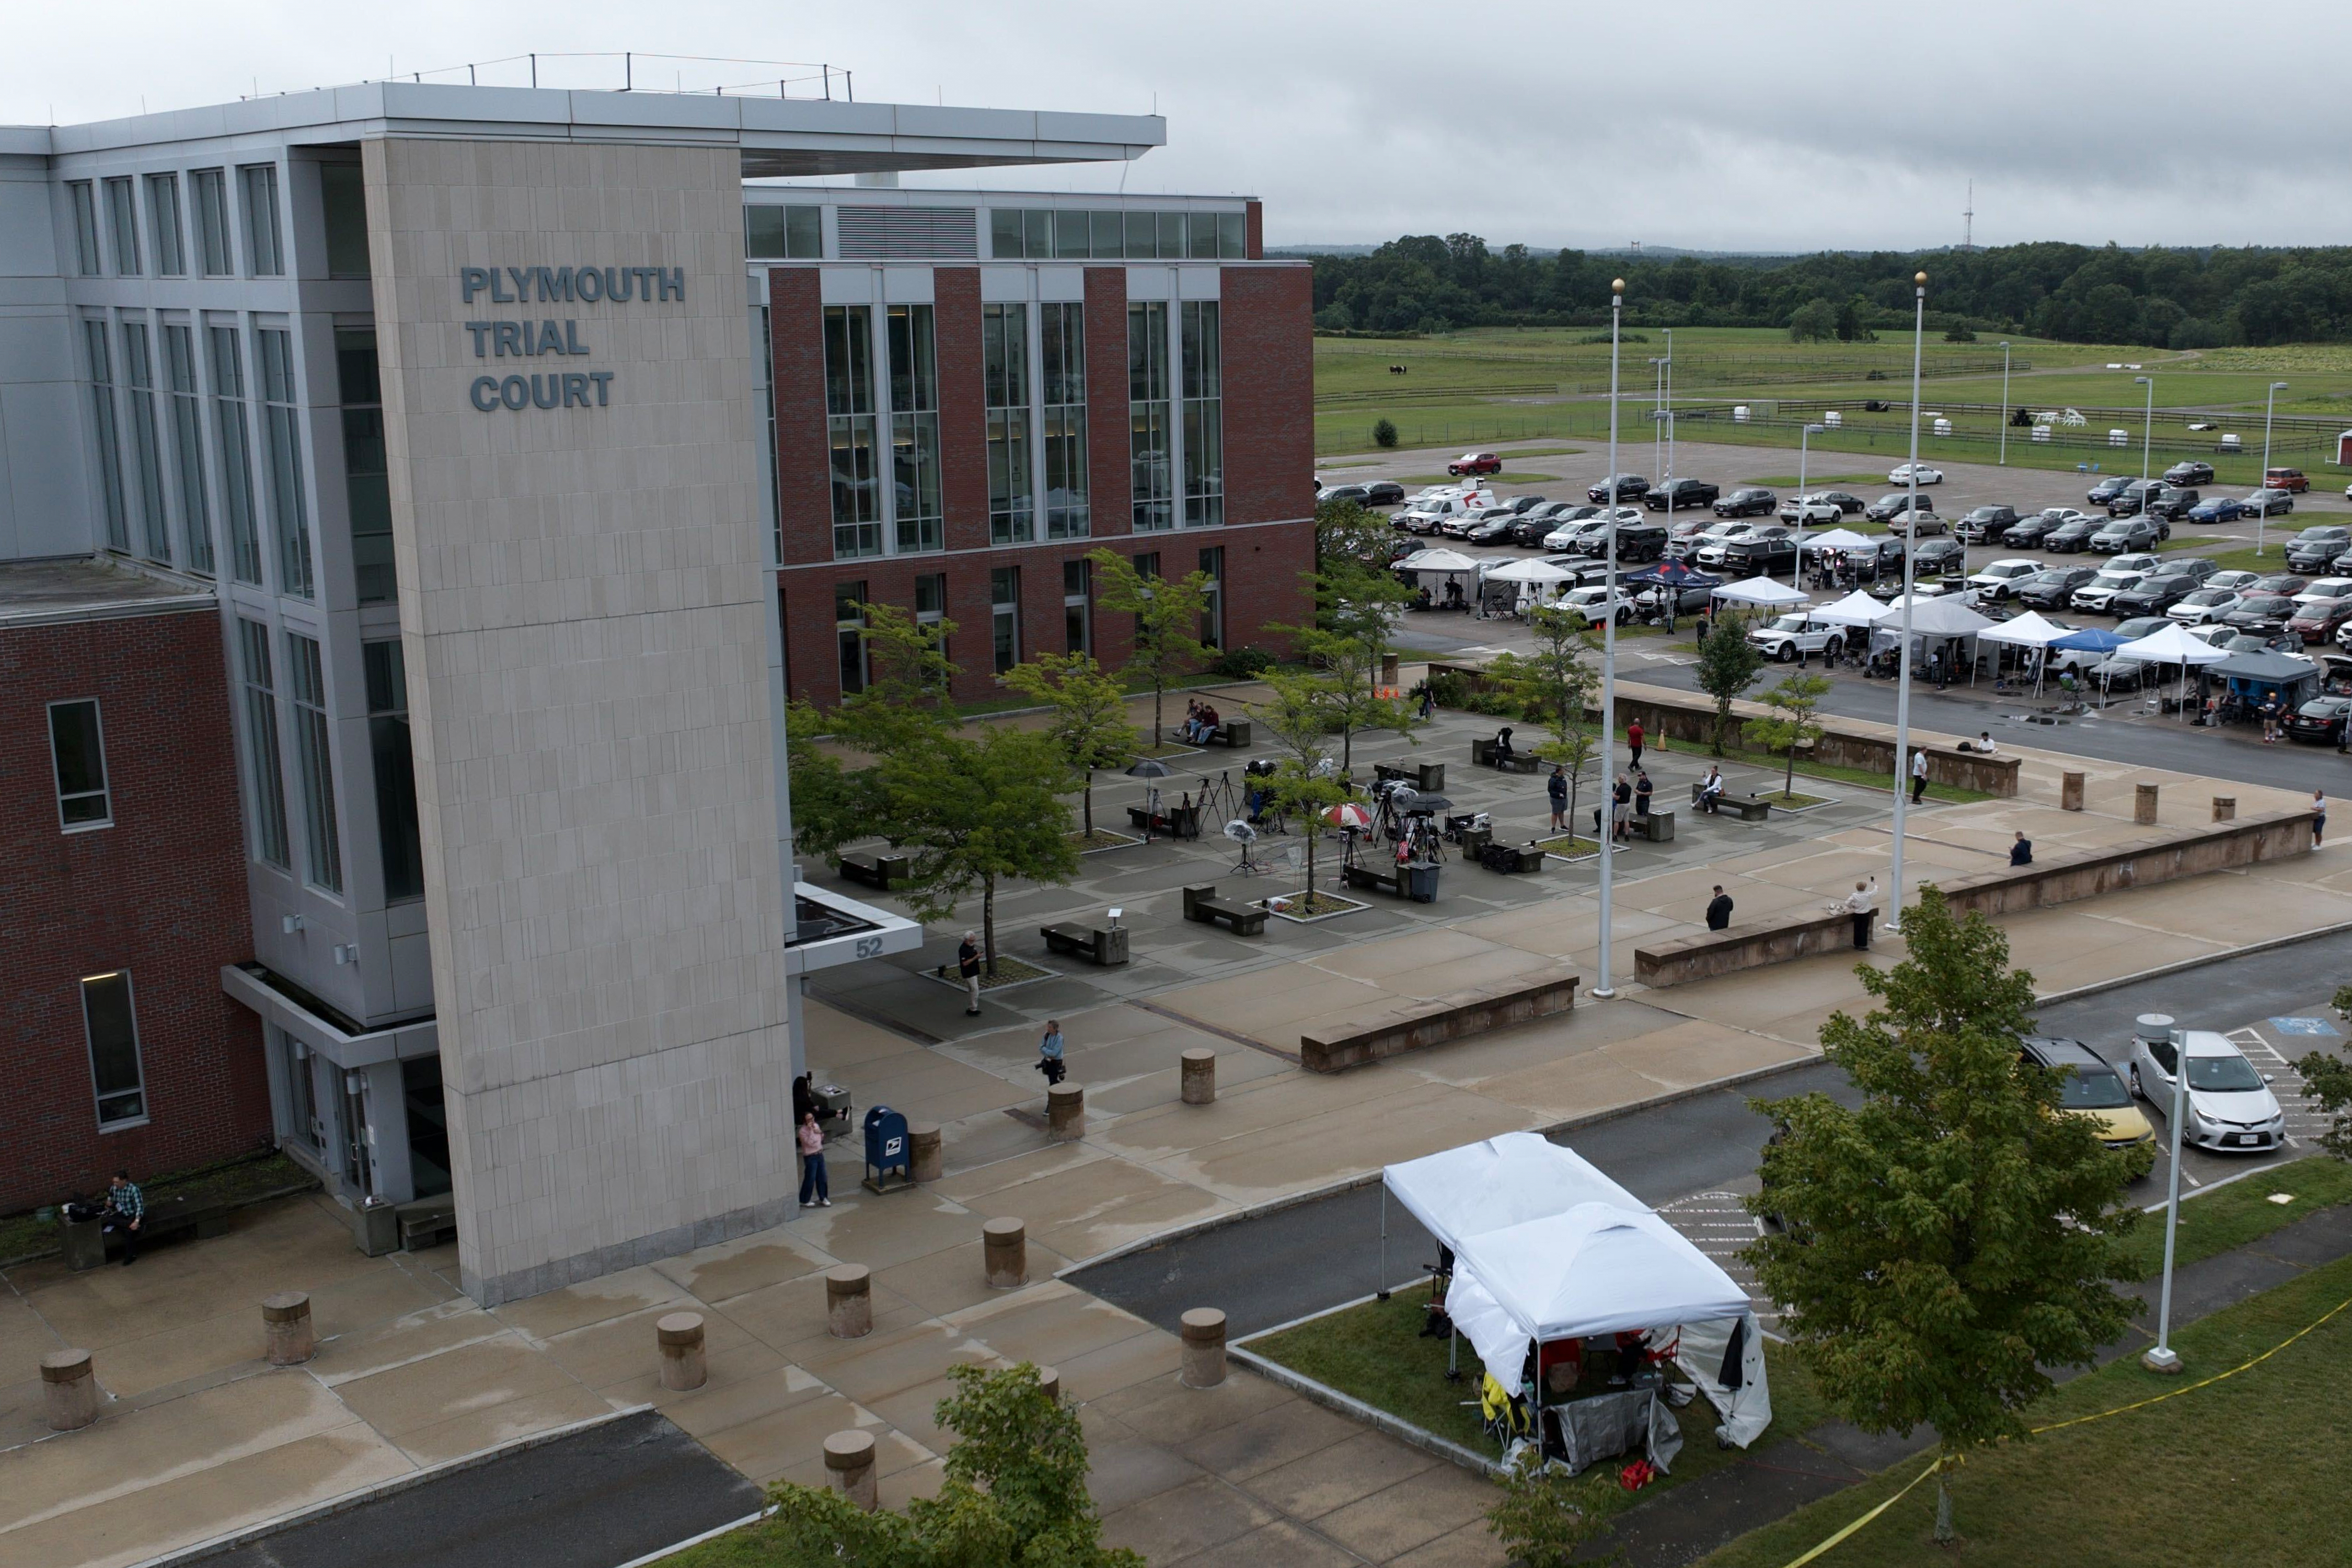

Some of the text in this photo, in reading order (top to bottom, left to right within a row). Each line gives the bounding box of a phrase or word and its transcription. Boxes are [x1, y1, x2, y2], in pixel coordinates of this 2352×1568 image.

[461, 267, 684, 303] PLYMOUTH
[466, 319, 590, 356] TRIAL
[470, 372, 614, 411] COURT
[857, 937, 883, 958] 52
